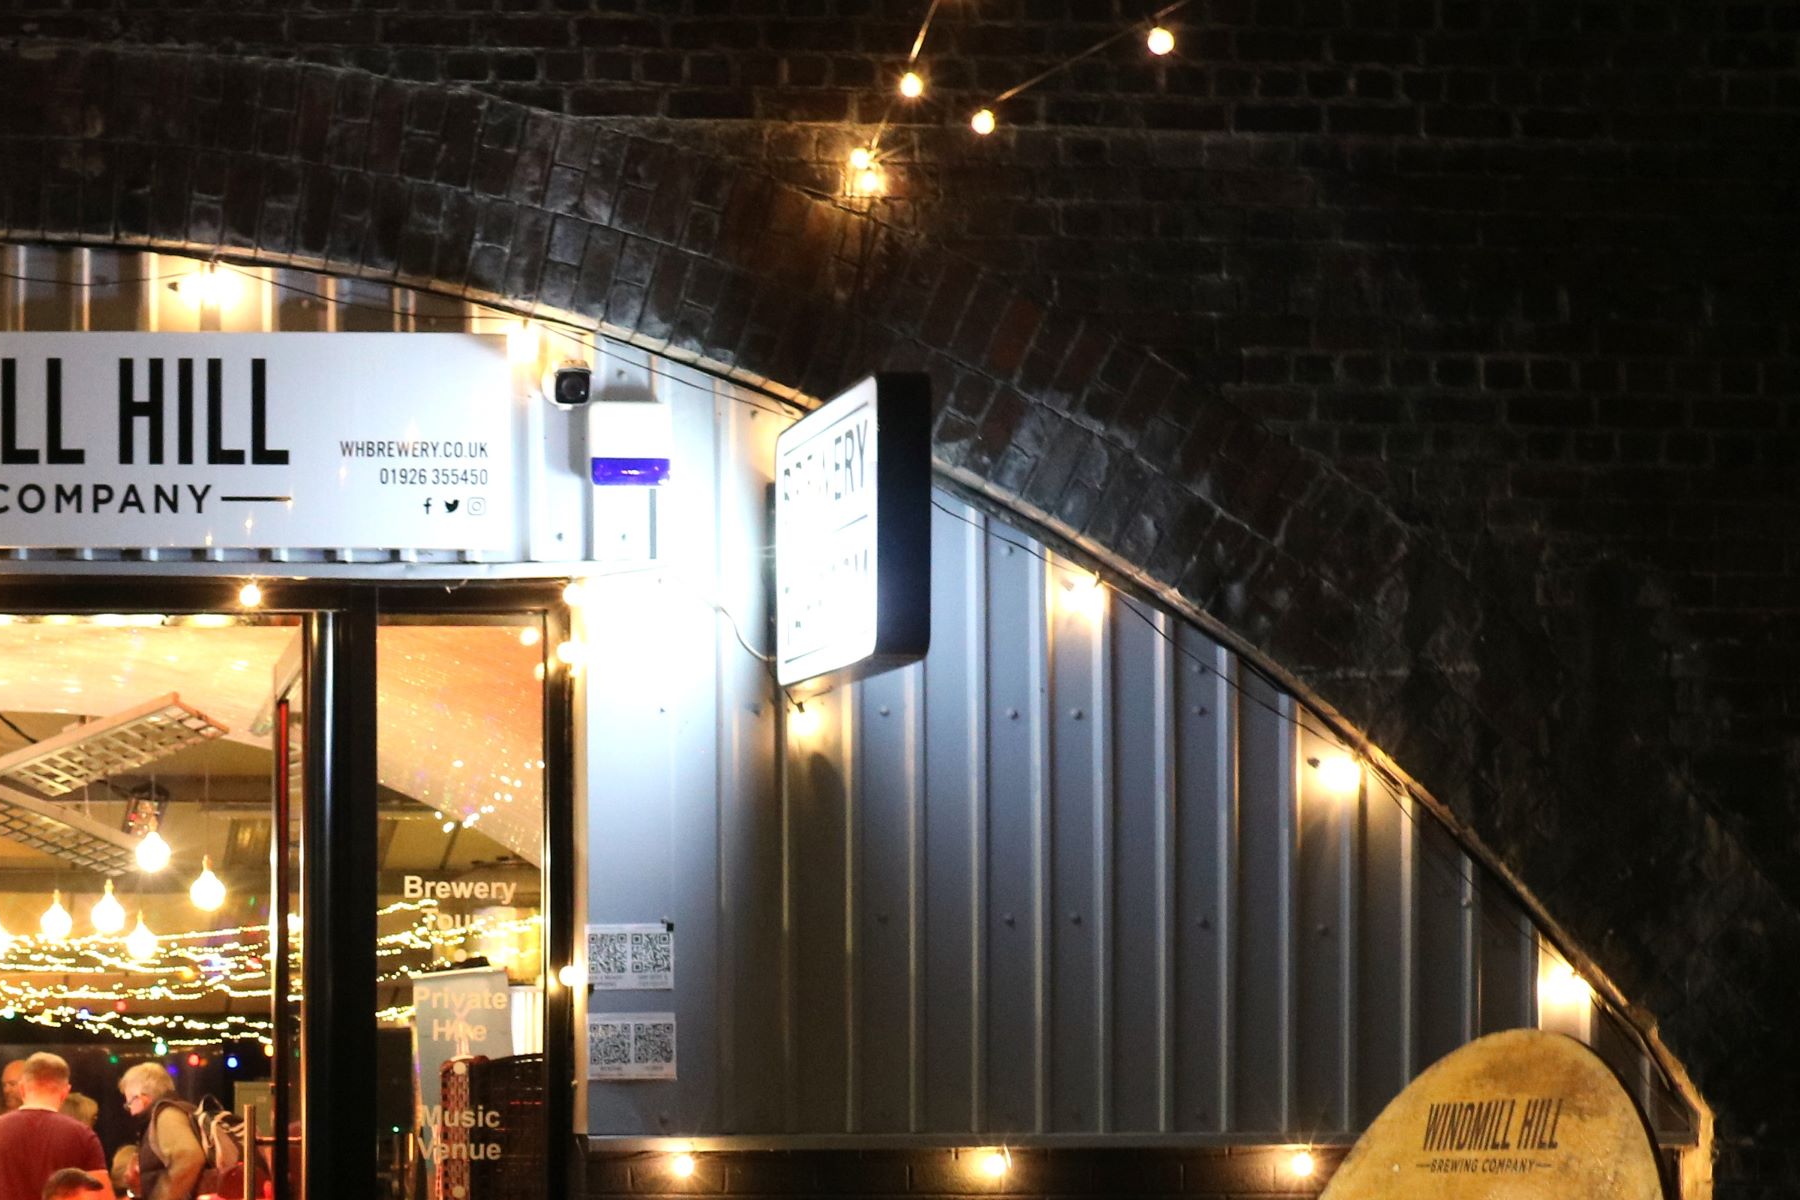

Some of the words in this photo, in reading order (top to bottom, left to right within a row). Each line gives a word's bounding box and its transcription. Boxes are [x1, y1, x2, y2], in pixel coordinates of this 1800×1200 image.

[118, 357, 289, 466] HILL
[339, 440, 488, 459] WHBREWERY.CO.UK
[379, 467, 428, 485] 01926
[431, 467, 488, 486] 355450
[403, 874, 517, 905] Brewery
[413, 985, 509, 1011] Private
[420, 1104, 501, 1128] Music
[1423, 1099, 1517, 1151] WINDMILL
[1517, 1098, 1566, 1150] HILL
[416, 1135, 502, 1160] Venue
[1429, 1157, 1480, 1174] BREWING
[1480, 1157, 1537, 1175] COMPANY
